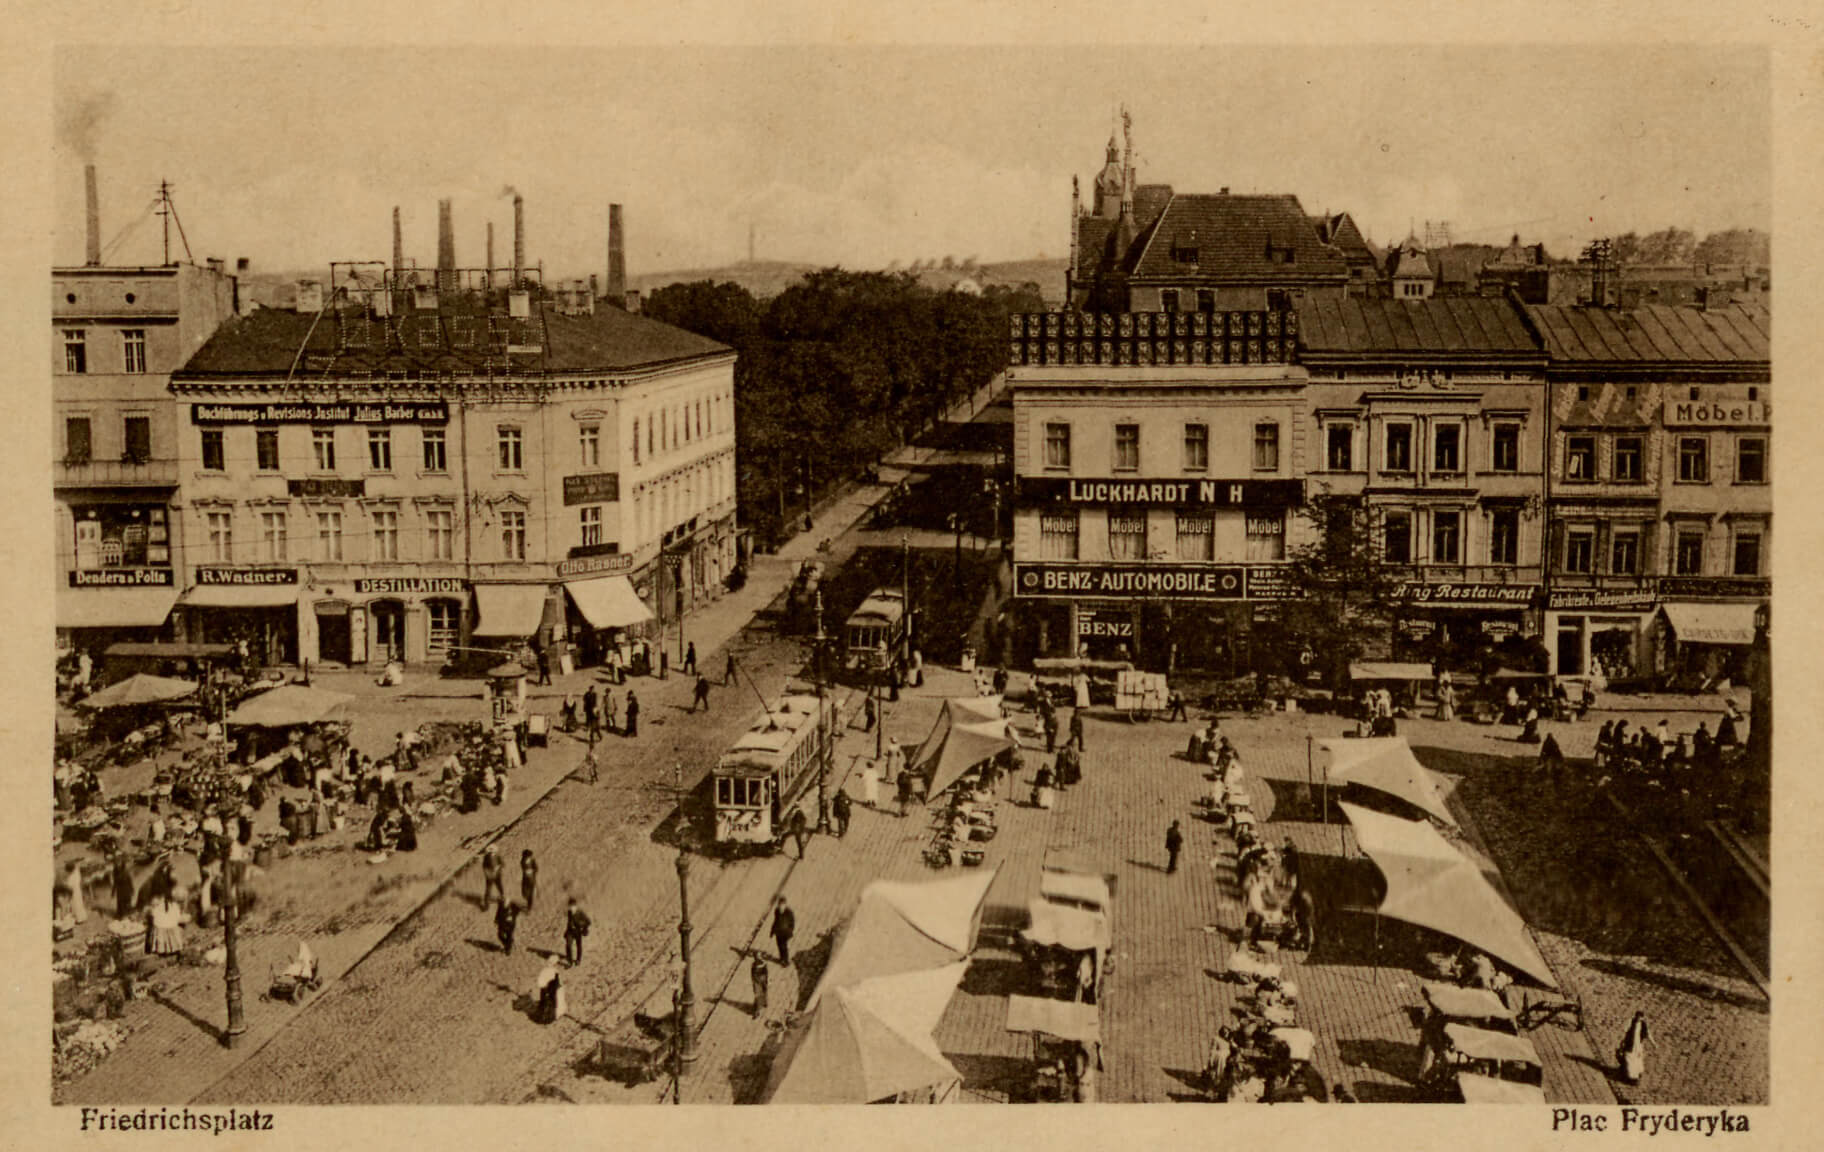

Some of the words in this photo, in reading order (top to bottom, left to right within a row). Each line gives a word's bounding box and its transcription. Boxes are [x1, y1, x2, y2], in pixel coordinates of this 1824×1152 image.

[267, 405, 312, 420] Revisions
[354, 405, 382, 420] Julius
[1069, 480, 1190, 502] LUCKHARDT
[1042, 516, 1076, 532] Möbel
[1110, 517, 1144, 533] Möbel
[1177, 517, 1212, 533] Möbel
[1247, 518, 1282, 534] Möbel
[1043, 571, 1216, 592] BENZ-AUTOMOBILE
[1079, 622, 1132, 636] BENZ
